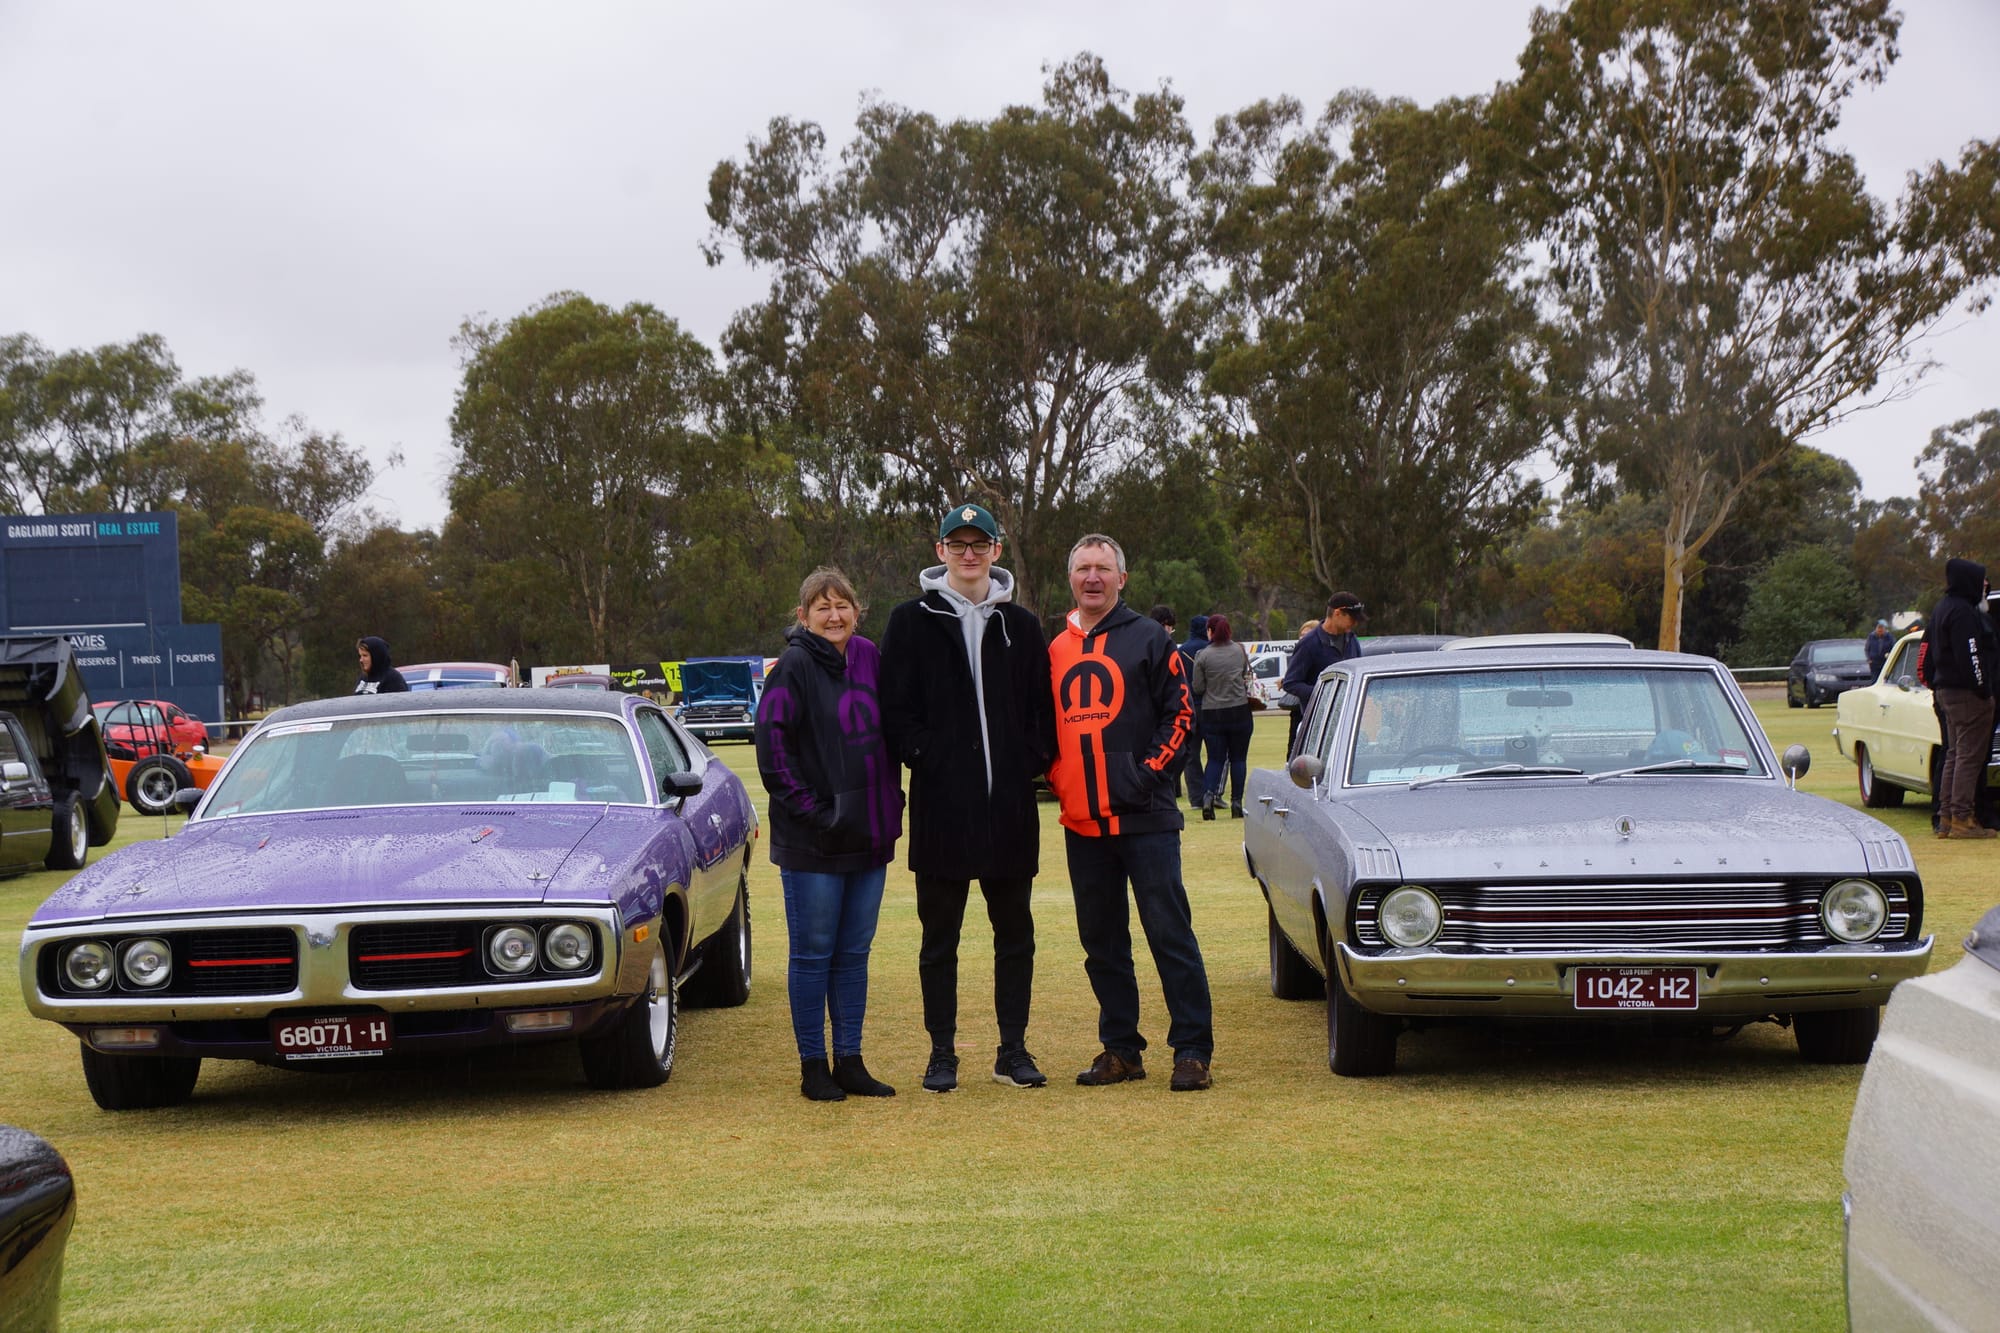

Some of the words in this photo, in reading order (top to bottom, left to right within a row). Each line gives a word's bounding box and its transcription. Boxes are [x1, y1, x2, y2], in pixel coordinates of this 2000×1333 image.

[8, 525, 59, 538] GAGLIARDI
[61, 524, 91, 536] SCOTT
[99, 523, 122, 535] REAL
[126, 522, 160, 534] ESTATE
[69, 634, 106, 647] AVIES
[77, 656, 117, 666] RESERVES
[132, 656, 161, 664] THIRDS
[176, 654, 216, 663] FOURTHS
[1063, 711, 1111, 725] MOPAR
[1619, 968, 1633, 976] CLUB
[1617, 1000, 1655, 1008] VICTORIA
[315, 1045, 352, 1053] VICTORIA
